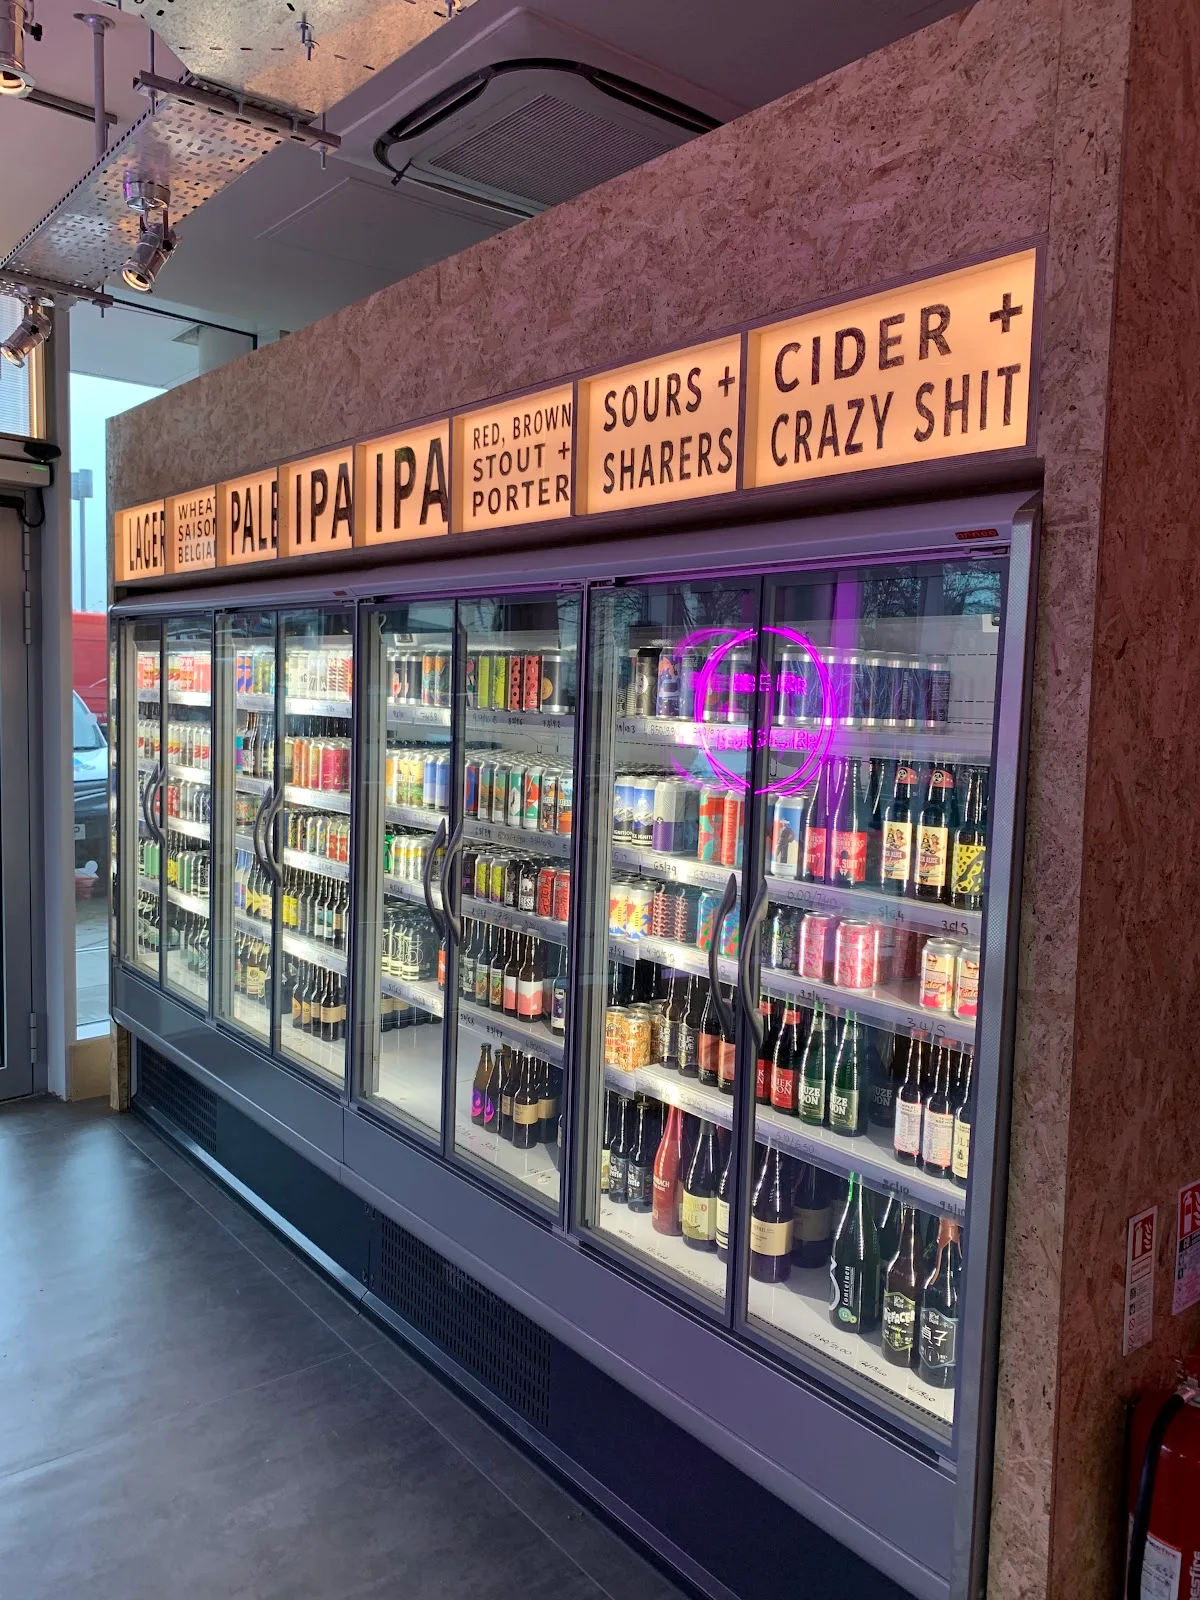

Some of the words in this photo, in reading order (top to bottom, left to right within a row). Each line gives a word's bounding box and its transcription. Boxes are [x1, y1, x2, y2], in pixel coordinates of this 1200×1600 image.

[774, 304, 951, 393] CIDER
[989, 292, 1023, 333] +
[473, 423, 506, 451] RED,
[512, 403, 572, 440] BROWN
[602, 367, 702, 432] SOURS
[717, 365, 736, 397] +
[771, 391, 894, 467] CRAZY
[913, 363, 1021, 443] SHIT
[375, 438, 449, 533] IPA
[472, 473, 570, 517] PORTER
[473, 443, 545, 482] STOUT
[558, 441, 571, 461] +
[602, 428, 733, 494] SHARERS
[231, 481, 278, 555] PALE
[295, 462, 353, 545] IPA
